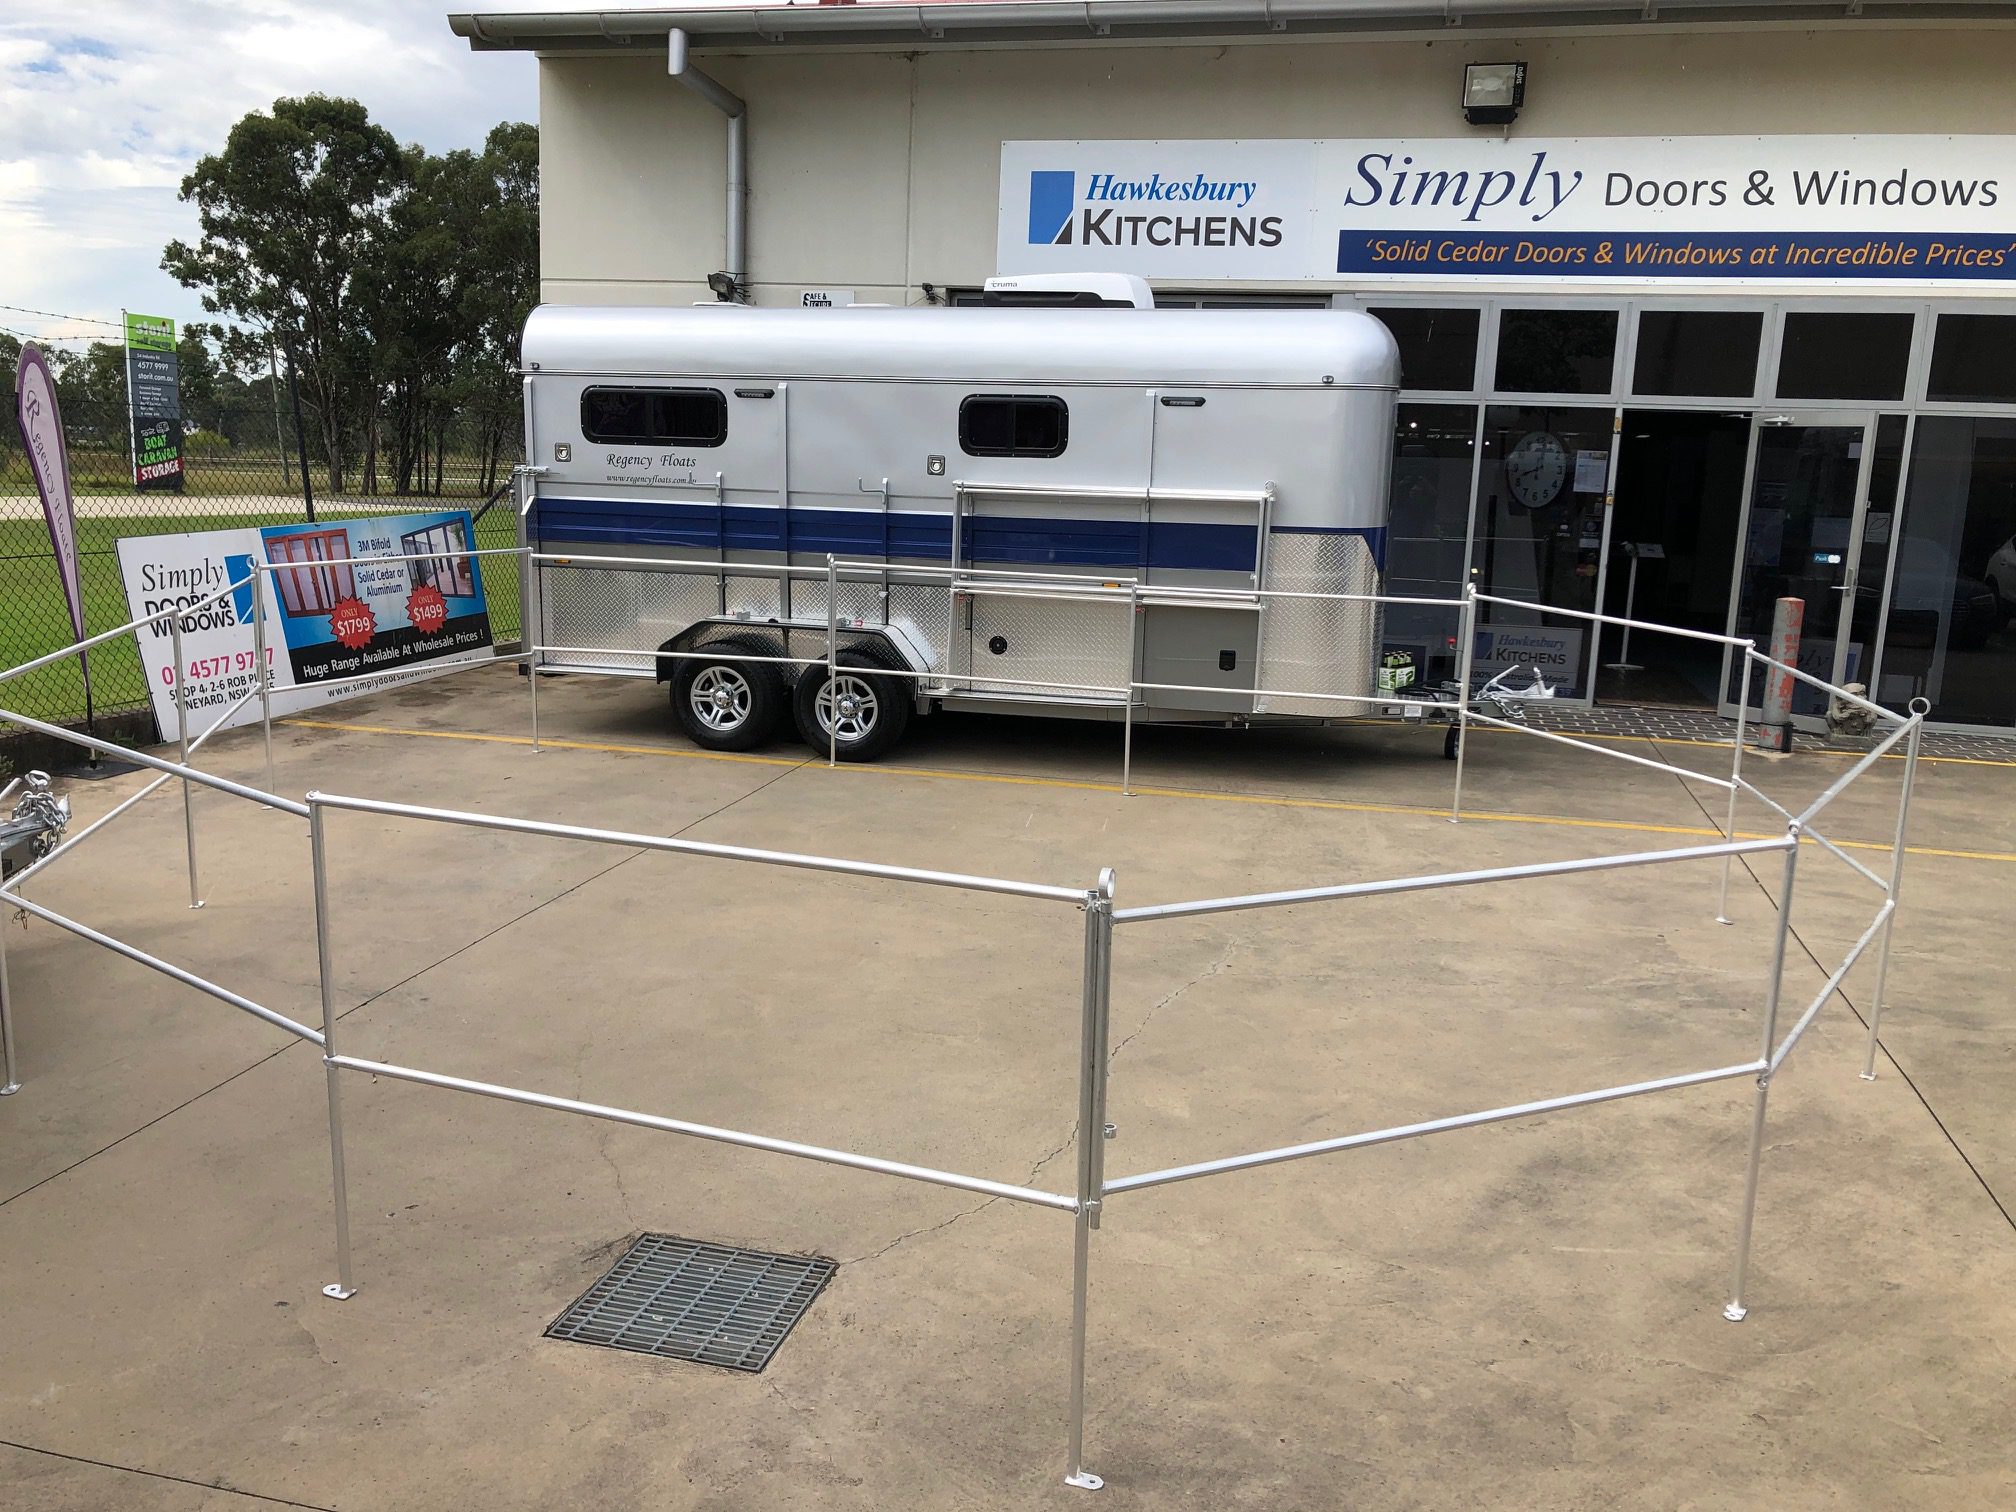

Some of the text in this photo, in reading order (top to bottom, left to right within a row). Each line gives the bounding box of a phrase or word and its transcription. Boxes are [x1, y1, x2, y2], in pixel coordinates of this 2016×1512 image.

[1085, 172, 1257, 209] Hawkesbury
[1343, 151, 1999, 222] Simply Doors & Windows
[1082, 208, 1283, 248] KITCHENS
[1437, 240, 1509, 263] Cedar
[1514, 241, 1587, 264] Doors
[1593, 242, 1615, 265] &
[1624, 241, 1743, 265] Windows
[1749, 246, 1779, 265] at
[1785, 241, 1918, 266] Incredible
[137, 361, 169, 372] 4577 9999
[25, 389, 55, 494] Regency
[144, 434, 167, 450] BOAT
[137, 446, 178, 466] CARAVAN
[606, 452, 697, 470] Regency Floats
[141, 459, 180, 480] STORAGE
[358, 537, 391, 552] 3M Bifold
[142, 558, 224, 594] Simply
[357, 567, 405, 584] Solid Cedar or
[367, 582, 404, 597] Aluminium
[418, 595, 434, 603] ONLY
[341, 608, 358, 618] ONLY
[414, 604, 442, 621] $1499
[337, 616, 371, 637] $1799
[1498, 634, 1566, 651] Hawkesbury
[303, 661, 329, 679] Huge
[331, 655, 361, 673] Range
[362, 647, 401, 666] Available
[402, 645, 412, 656] At
[413, 636, 455, 654] Wholesale
[456, 632, 479, 645] Prices
[1496, 648, 1567, 665] KITCHENS
[162, 647, 274, 685] 0 4577 977
[169, 685, 196, 700] SOP
[210, 680, 226, 692] 2-6
[227, 676, 247, 689] ROB
